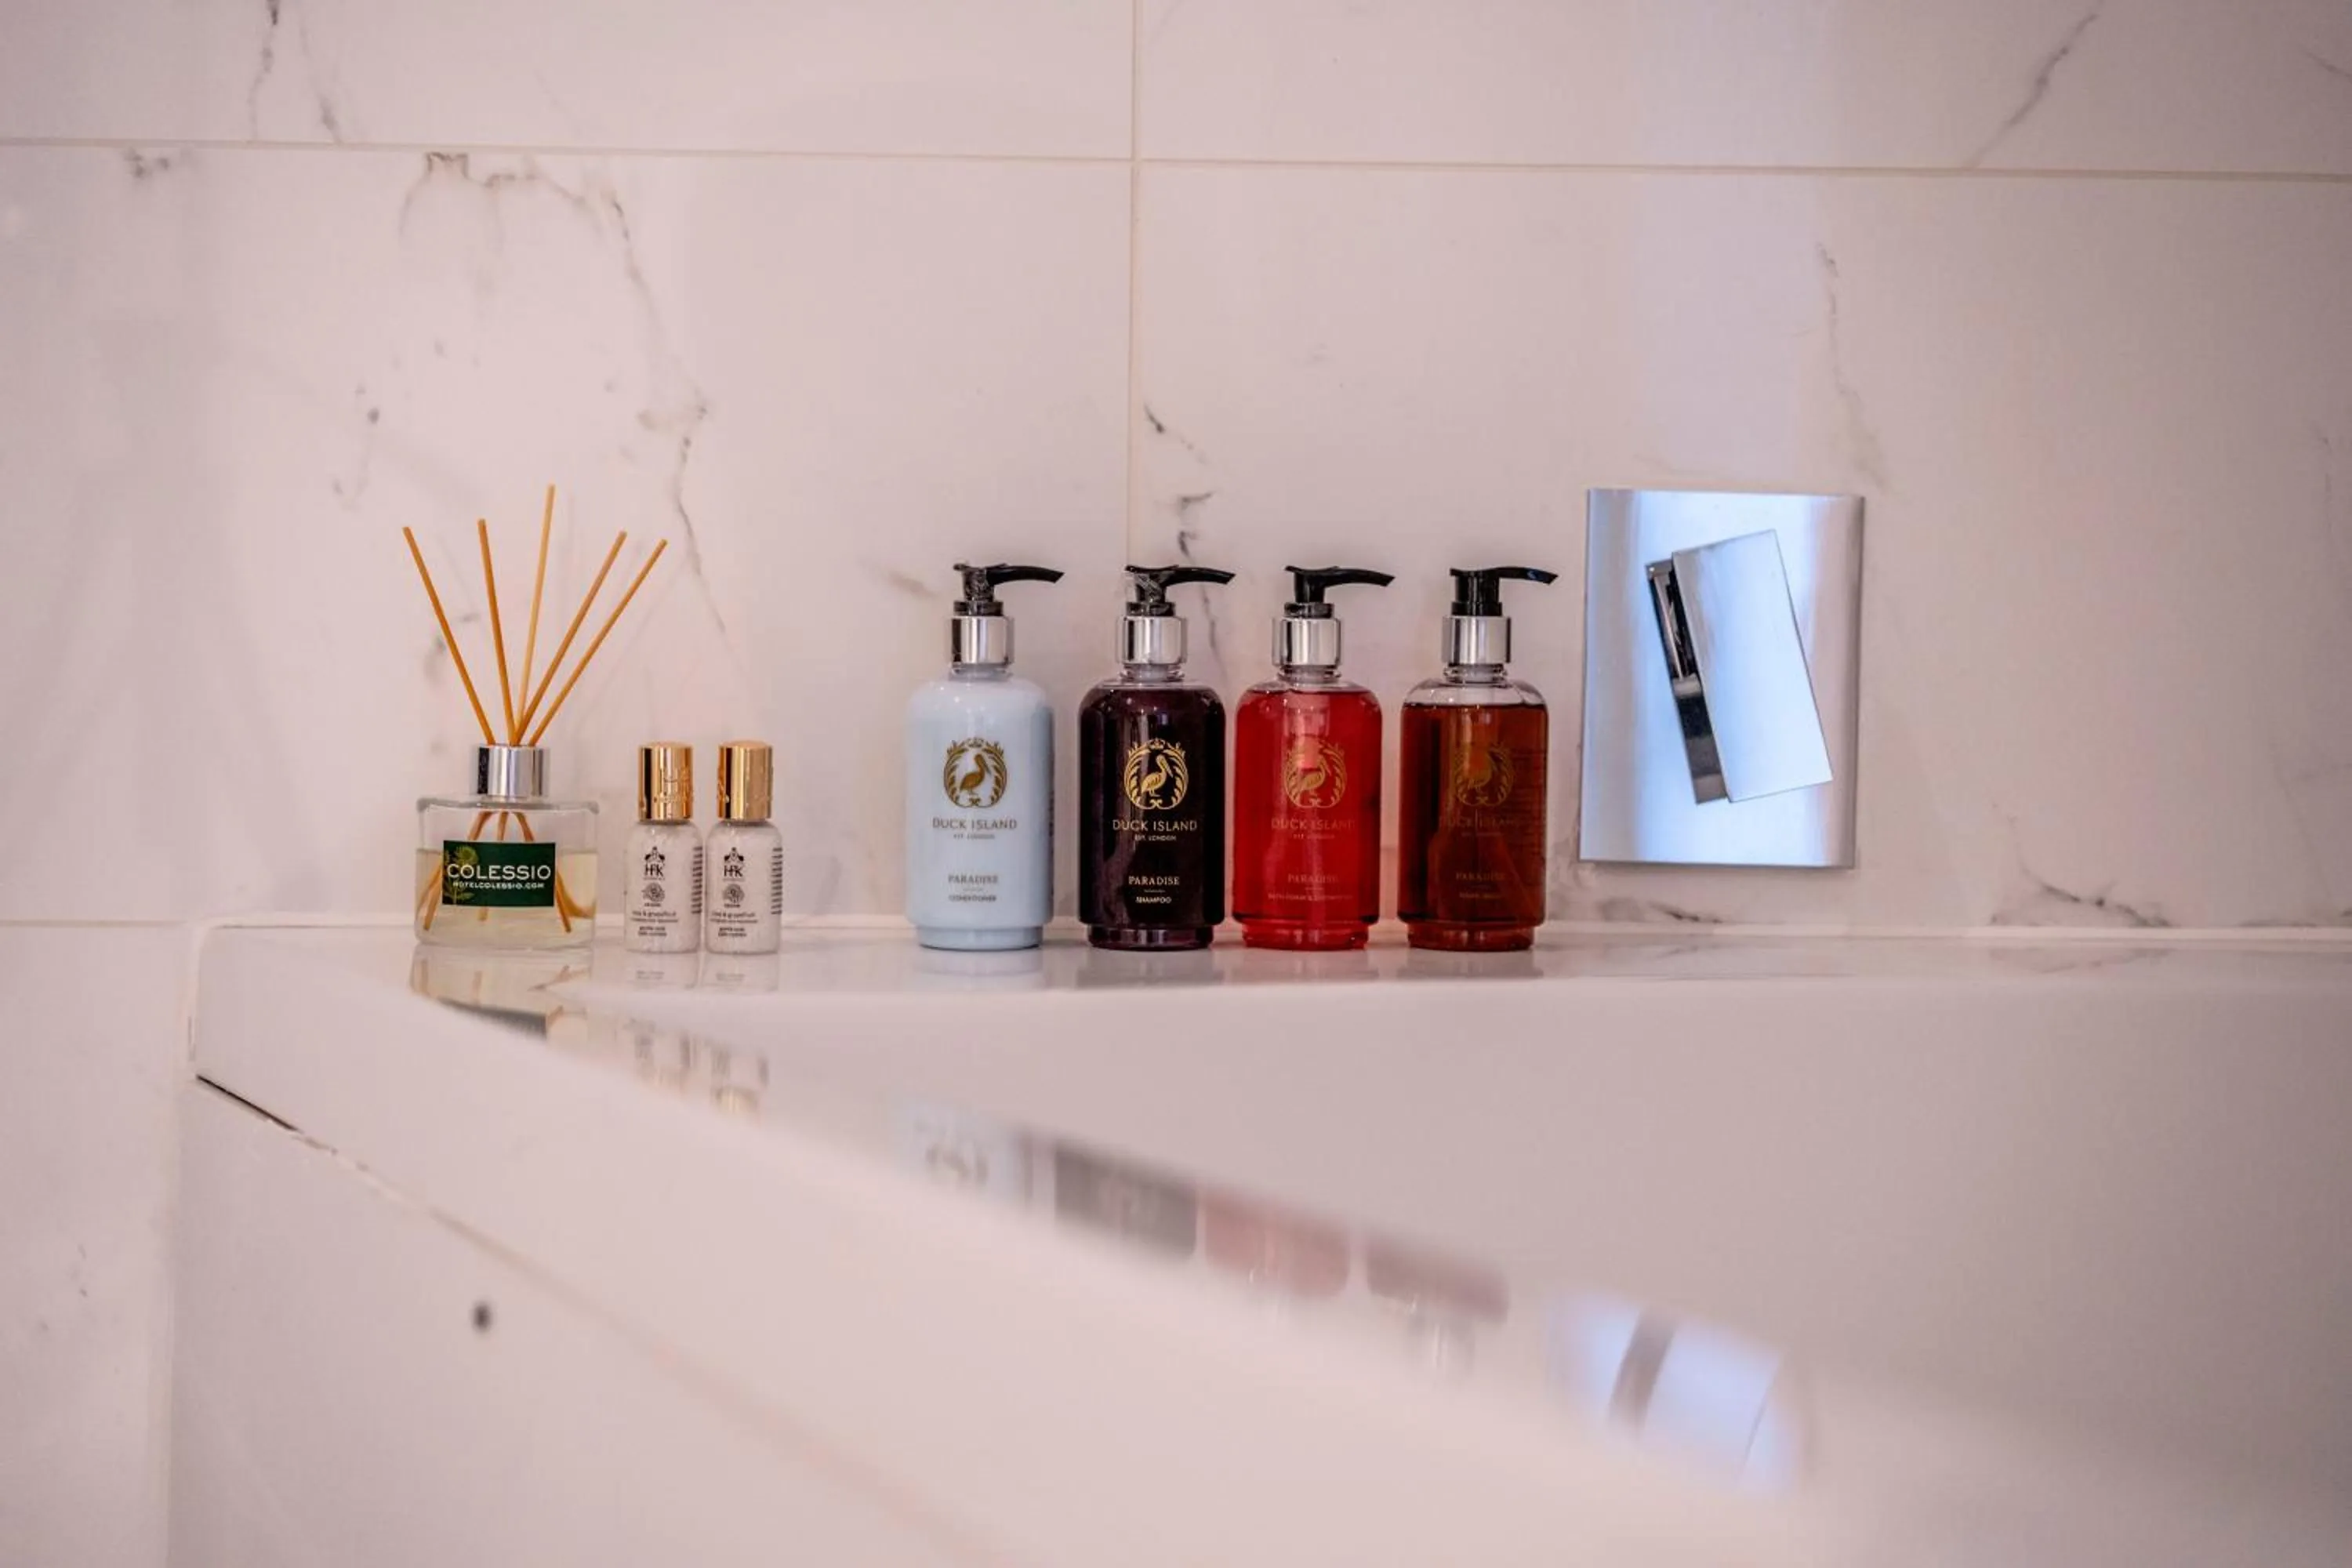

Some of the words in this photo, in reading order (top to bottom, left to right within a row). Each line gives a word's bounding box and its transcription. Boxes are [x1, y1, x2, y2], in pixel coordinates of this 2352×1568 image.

[931, 817, 967, 829] DUCK
[971, 818, 1018, 830] ISLAND
[1112, 819, 1149, 831] DUCK
[1153, 819, 1198, 832] ISLAND
[447, 863, 551, 880] COLESSIO
[452, 881, 545, 890] HOTELCOLESSIO.COM
[1127, 876, 1180, 886] PARADISE
